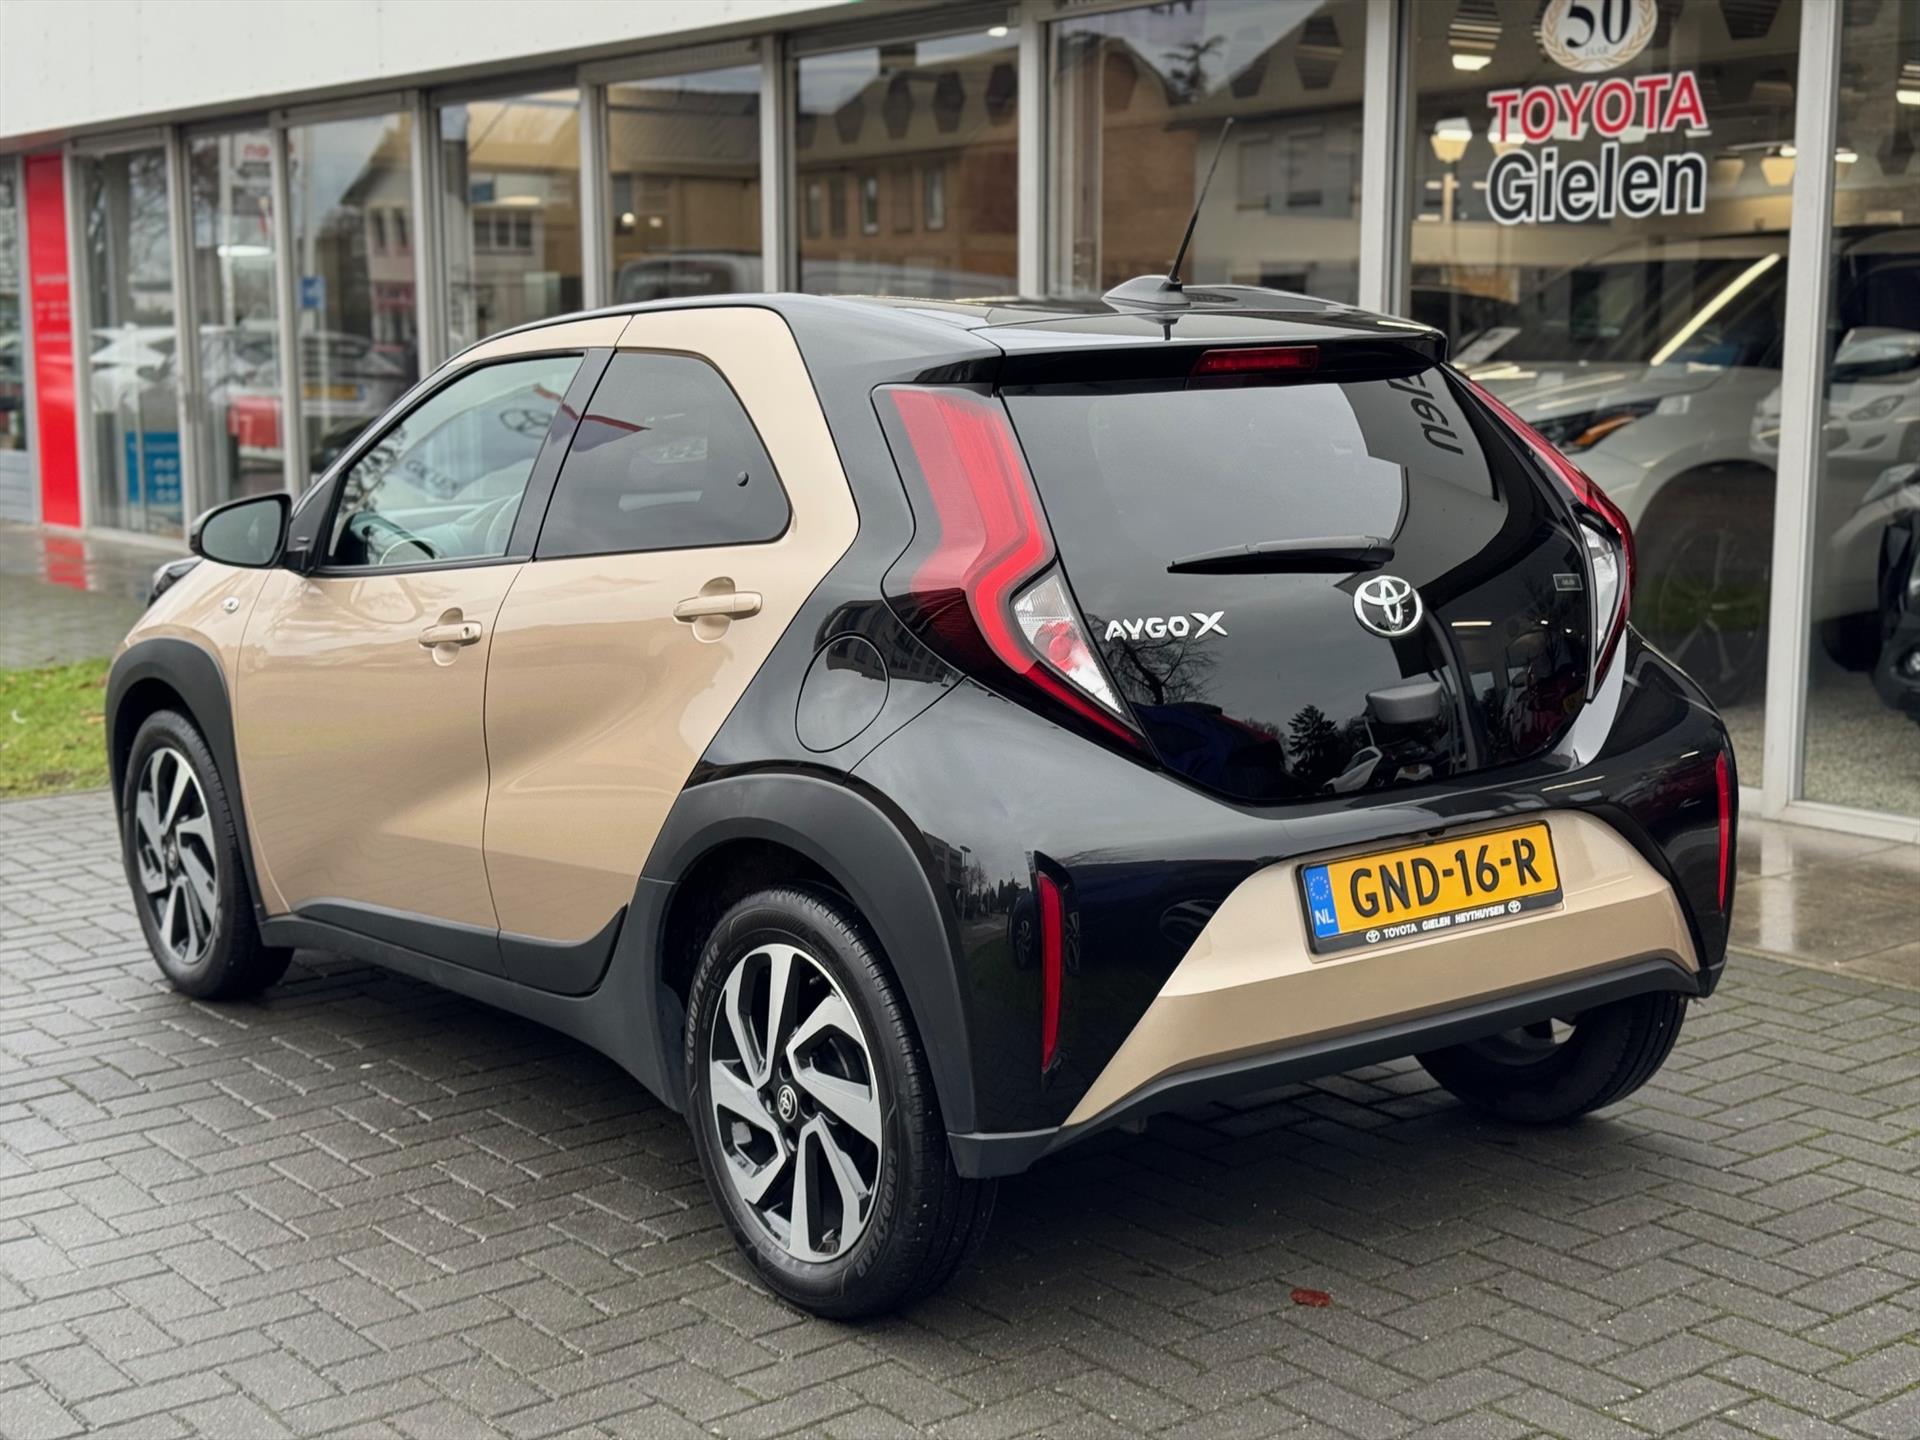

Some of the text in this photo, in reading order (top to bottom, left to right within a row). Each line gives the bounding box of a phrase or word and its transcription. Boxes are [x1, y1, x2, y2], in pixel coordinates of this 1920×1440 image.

[1566, 0, 1631, 48] 50
[1488, 72, 1708, 143] TOYOTA
[1487, 142, 1707, 225] Gielen
[1104, 611, 1228, 641] AYGO X
[1350, 838, 1542, 918] GND-16-R
[1314, 908, 1335, 926] NL
[1382, 904, 1505, 939] TOYOTA GIELEN HEYTHUYSEN
